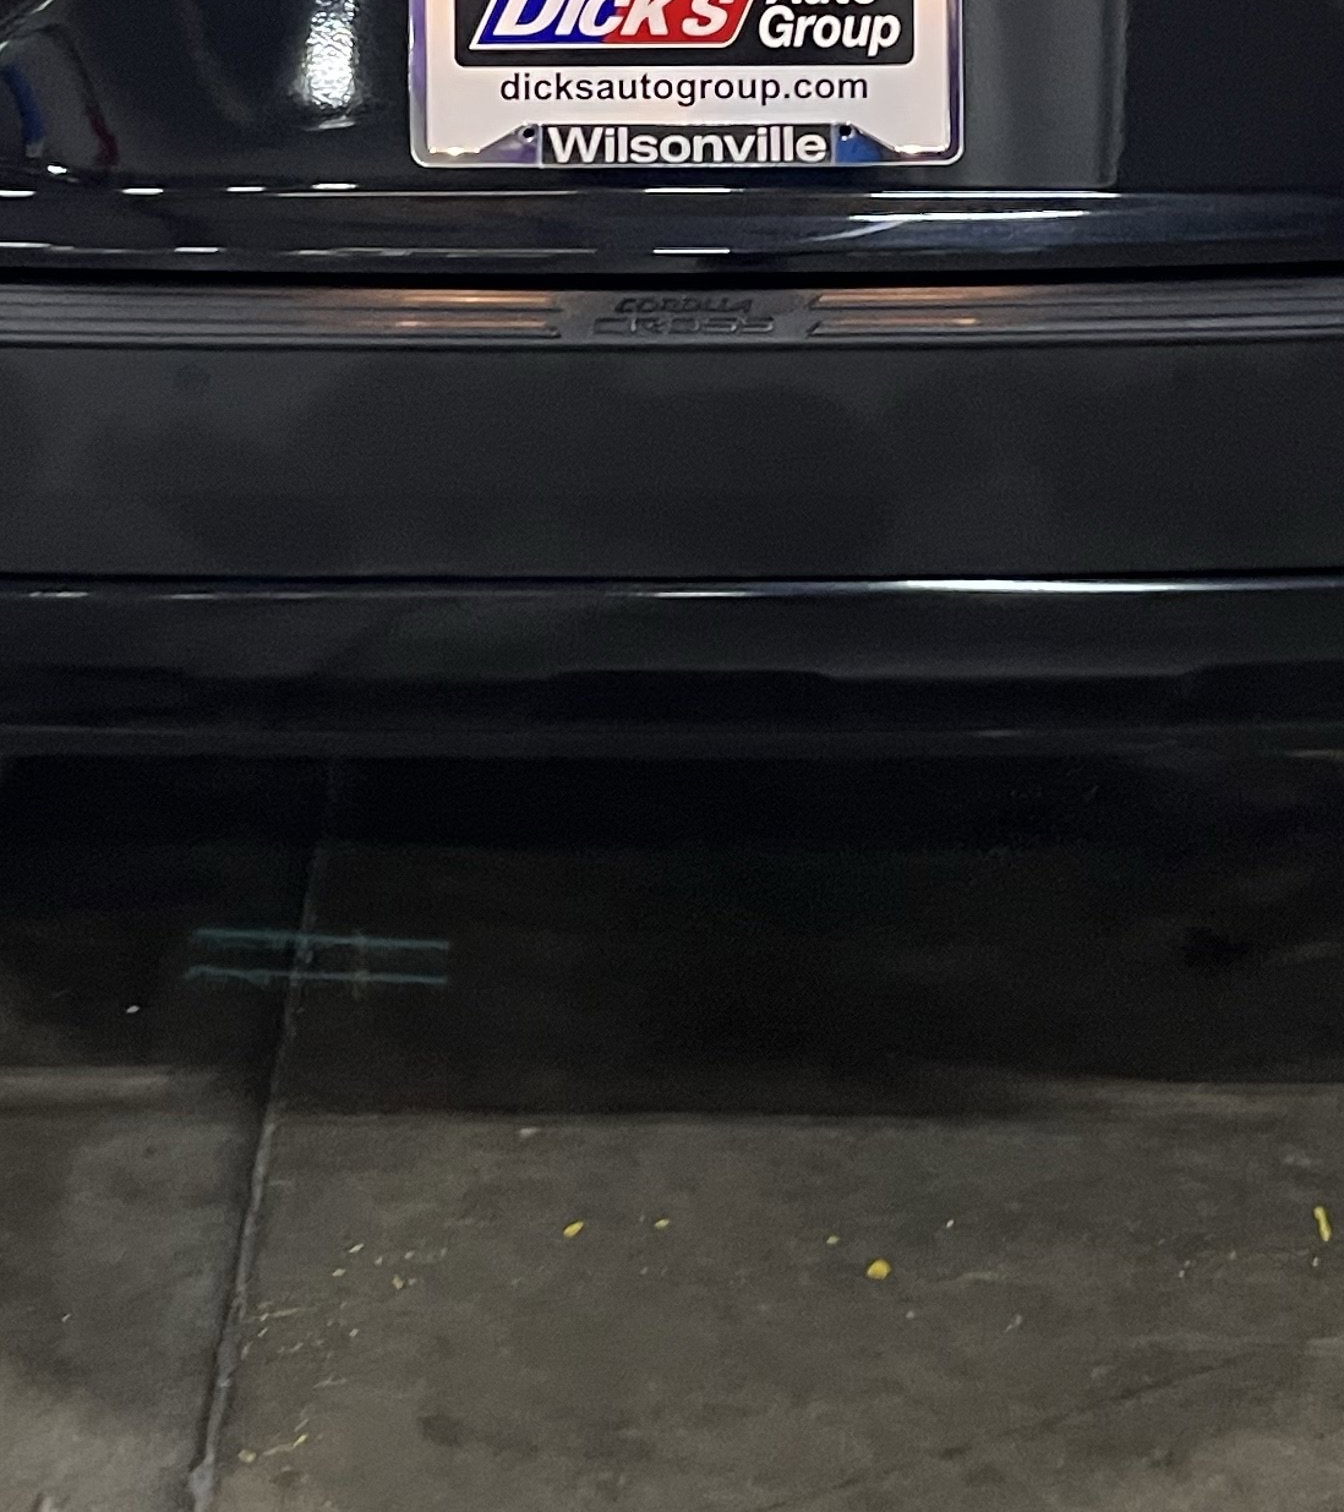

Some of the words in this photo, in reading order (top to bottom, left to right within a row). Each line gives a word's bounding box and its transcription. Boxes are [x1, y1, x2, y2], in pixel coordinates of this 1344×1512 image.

[758, 6, 902, 57] Group
[500, 72, 869, 107] dicksautogroup.com
[547, 125, 829, 164] Wilsonville
